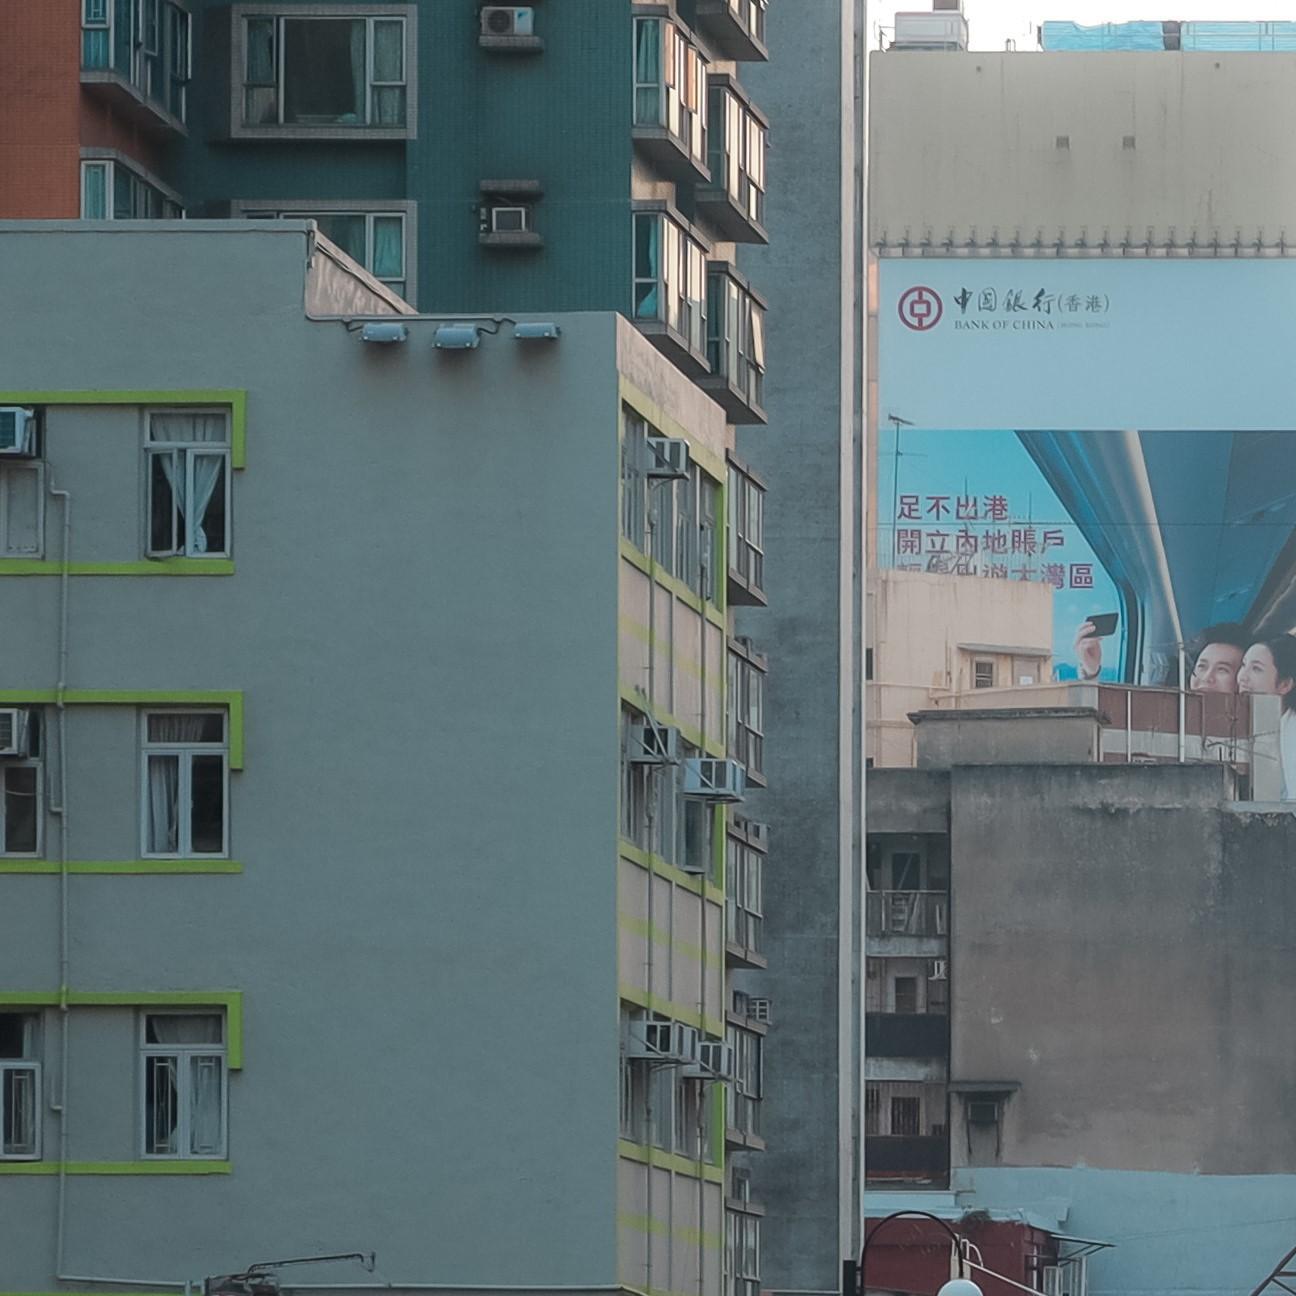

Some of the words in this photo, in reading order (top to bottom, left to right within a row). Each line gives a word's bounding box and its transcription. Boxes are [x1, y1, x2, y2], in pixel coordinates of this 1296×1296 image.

[954, 320, 990, 331] BANK
[992, 320, 1008, 331] OF
[1012, 320, 1054, 331] CHINA
[897, 495, 1008, 521] 足不出港
